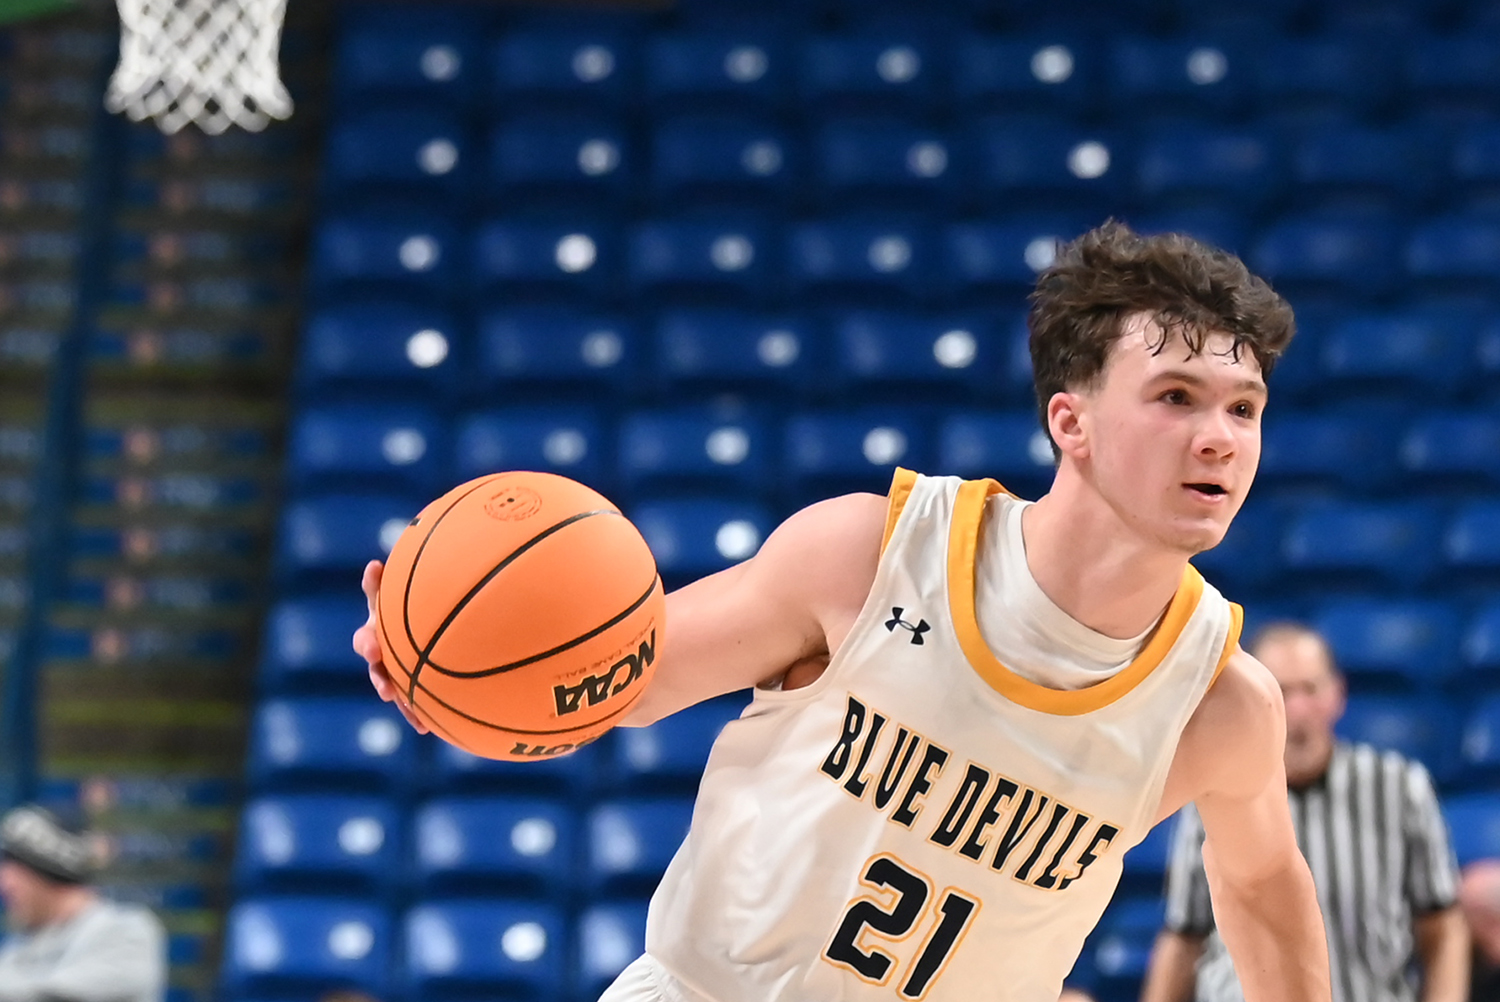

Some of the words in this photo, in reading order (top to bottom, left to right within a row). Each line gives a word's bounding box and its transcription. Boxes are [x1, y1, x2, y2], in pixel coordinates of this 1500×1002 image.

[553, 627, 655, 717] NCAA
[554, 666, 587, 680] BALL
[818, 692, 951, 830] BLUE
[928, 762, 1122, 890] DEVILS
[821, 853, 982, 1002] 21
